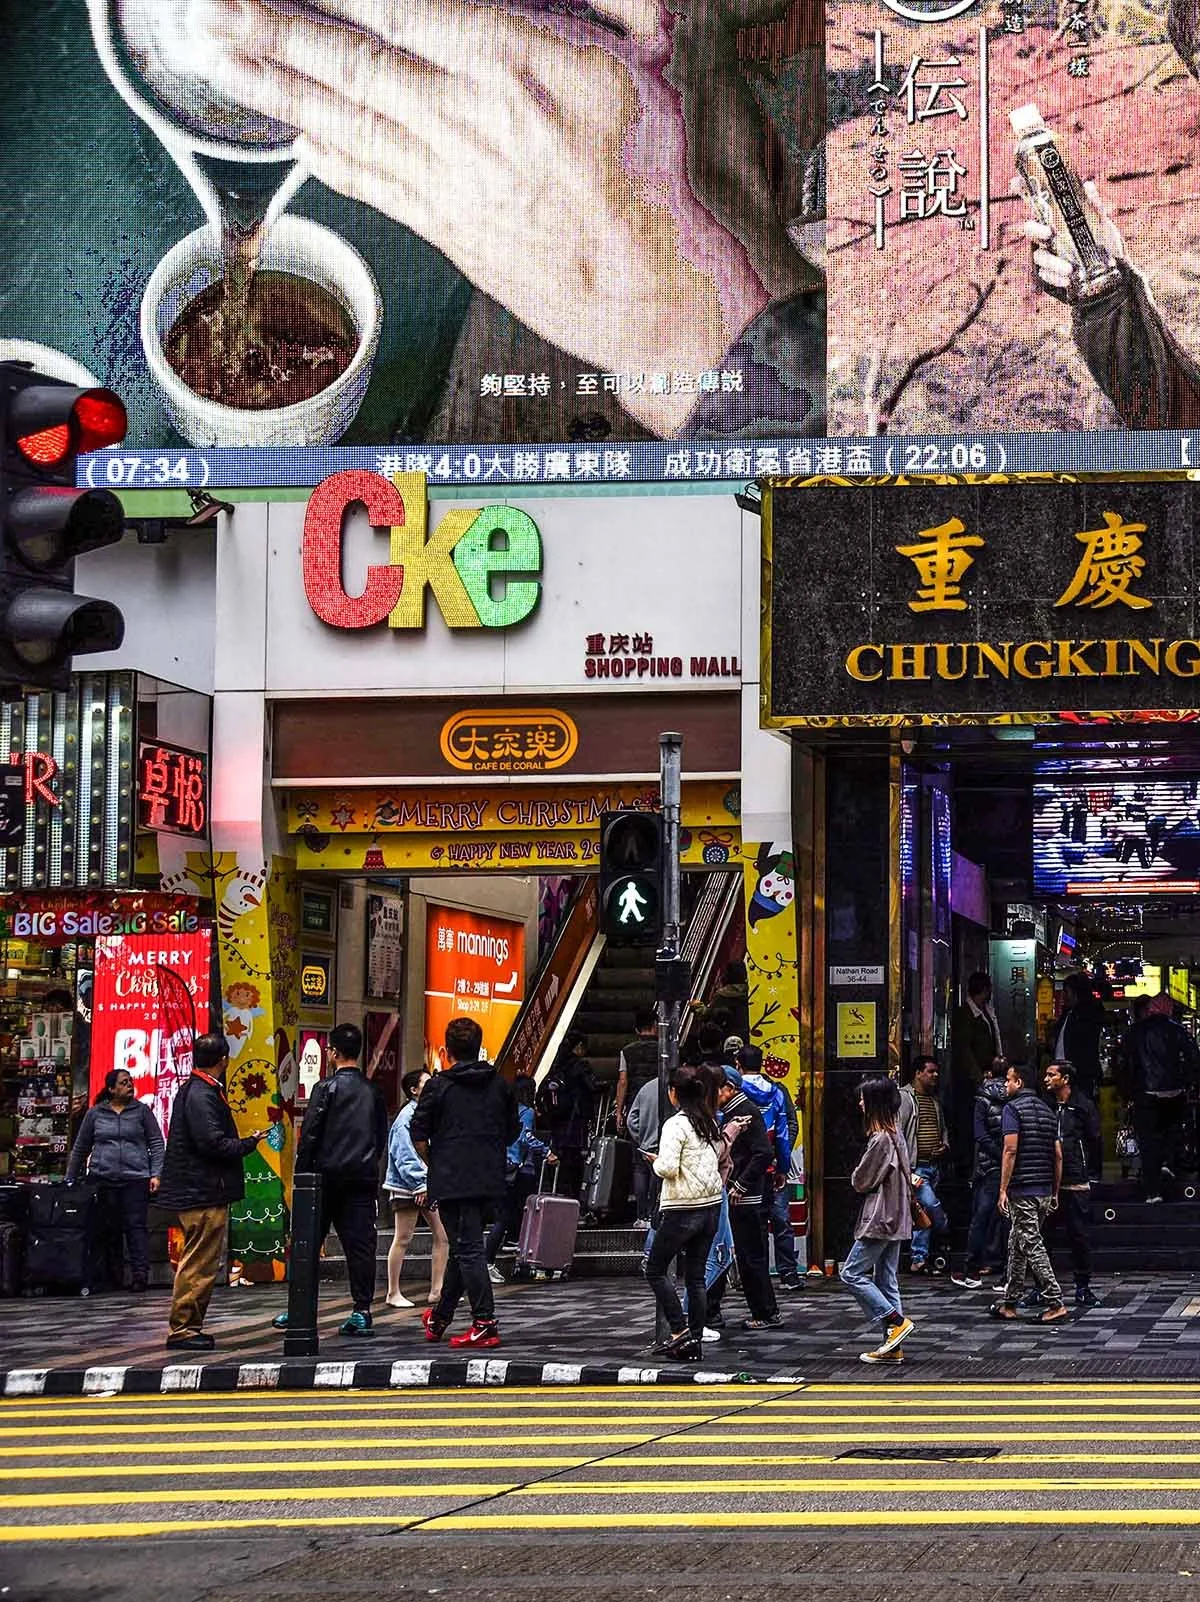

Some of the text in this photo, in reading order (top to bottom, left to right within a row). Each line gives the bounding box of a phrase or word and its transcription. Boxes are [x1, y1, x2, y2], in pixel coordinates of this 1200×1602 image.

[303, 469, 543, 629] Cke
[585, 632, 654, 656] 重庆站
[584, 656, 742, 679] SHOPPING MALL
[499, 762, 512, 771] DE
[513, 761, 544, 771] CORAL
[398, 799, 488, 829] MERRY
[450, 842, 496, 861] HAPPY
[500, 842, 534, 859] NEW
[537, 841, 578, 860] YEAR
[580, 838, 601, 860] 20
[14, 912, 56, 936] BIG
[62, 911, 113, 936] Sale
[153, 911, 199, 935] Sale
[128, 950, 193, 966] MERRY
[457, 930, 509, 966] mannings
[836, 967, 879, 975] Nathan Road
